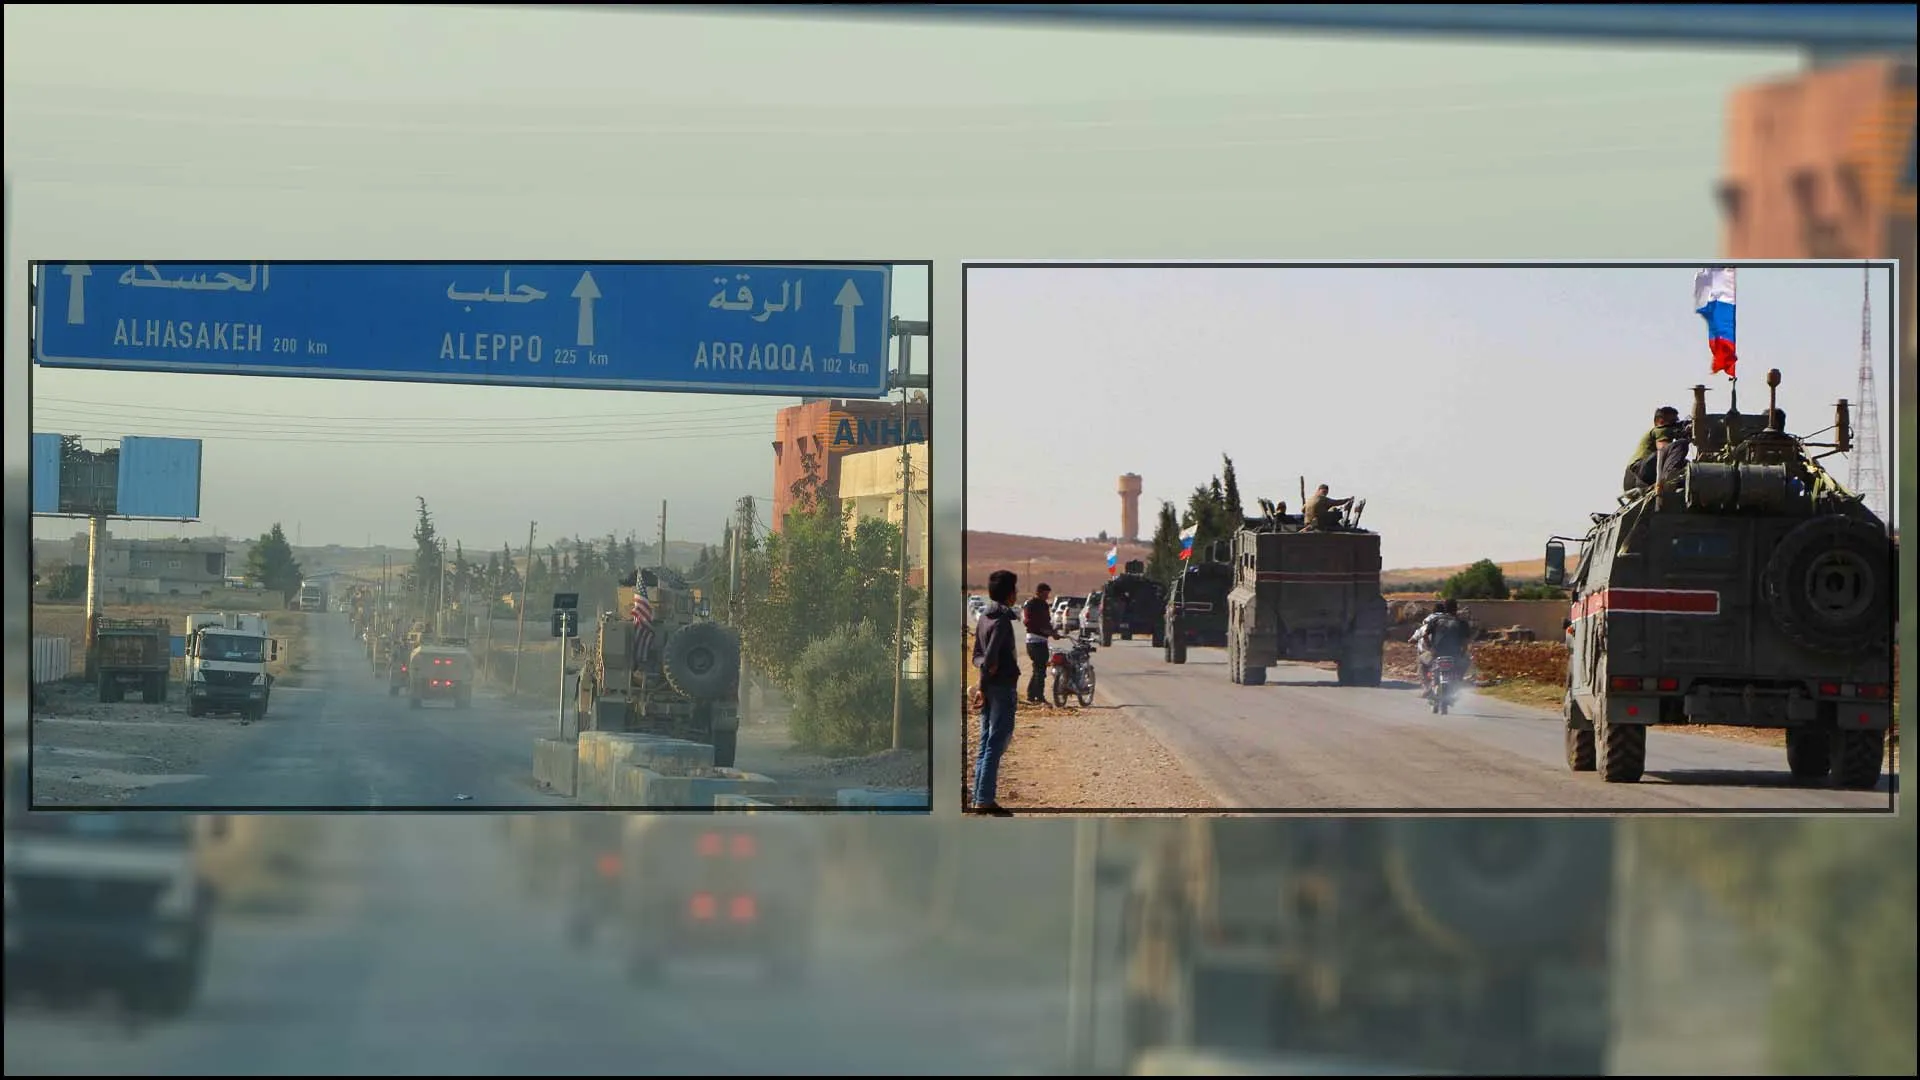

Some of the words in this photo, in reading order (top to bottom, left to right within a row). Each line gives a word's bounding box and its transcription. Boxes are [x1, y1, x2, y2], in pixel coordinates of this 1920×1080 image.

[447, 266, 547, 312] حلب
[708, 272, 803, 321] الرقة
[113, 318, 263, 351] ALHASAKEH
[272, 337, 298, 353] 200
[308, 339, 328, 354] km
[440, 332, 543, 362] ALEPPO
[554, 348, 577, 365] 225
[588, 350, 609, 366] km
[693, 341, 815, 373] ARRAQQA
[822, 356, 842, 374] 102
[849, 358, 869, 375] km
